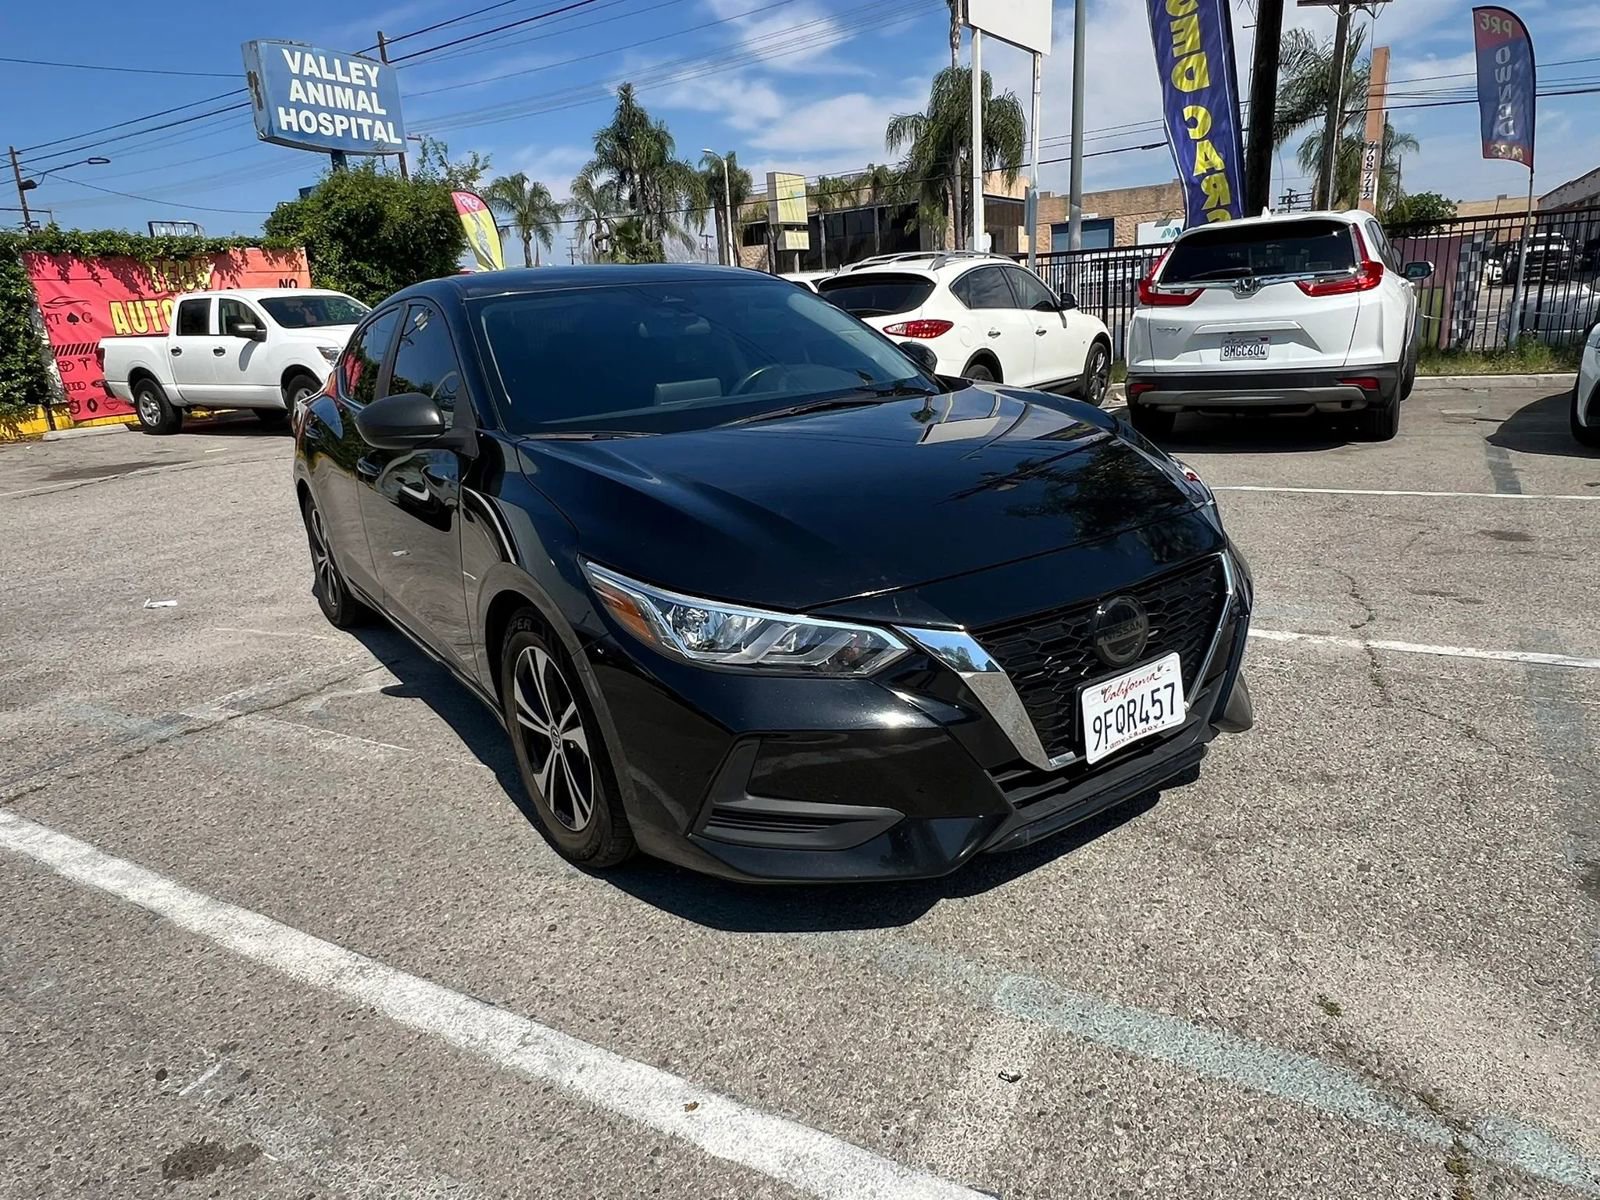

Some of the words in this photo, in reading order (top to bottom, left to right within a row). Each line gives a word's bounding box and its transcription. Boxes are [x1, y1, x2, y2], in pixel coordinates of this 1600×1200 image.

[282, 48, 380, 88] VALLEY
[289, 78, 387, 116] ANIMAL
[277, 106, 403, 144] HOSPITAL
[1223, 344, 1266, 357] 8MGC604
[1104, 619, 1144, 642] NISSAN
[1101, 672, 1162, 703] California
[1093, 682, 1175, 751] 9FQR457
